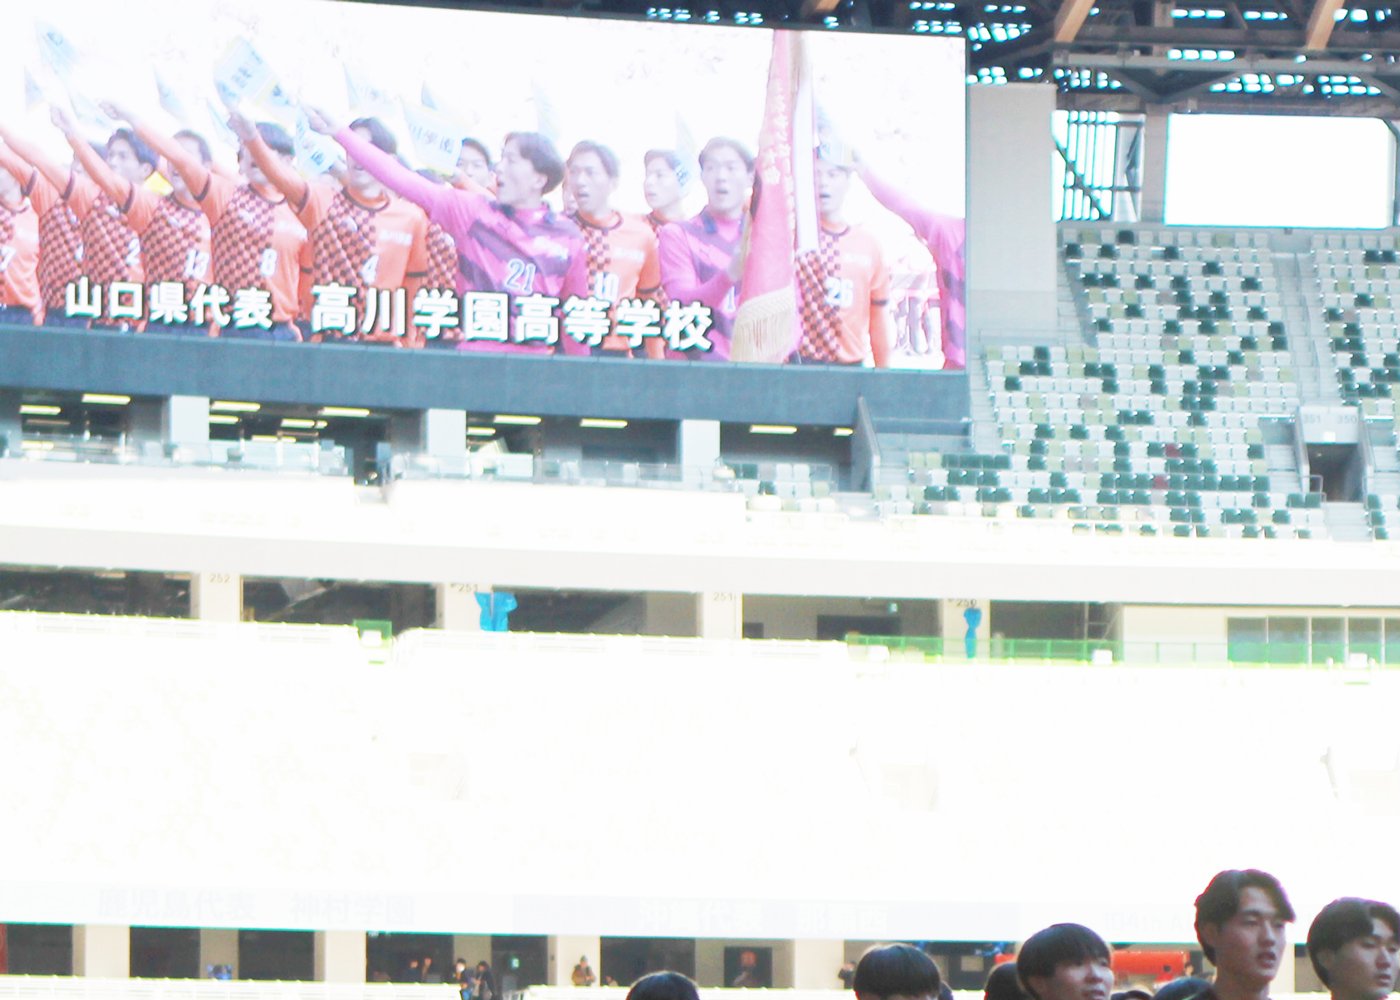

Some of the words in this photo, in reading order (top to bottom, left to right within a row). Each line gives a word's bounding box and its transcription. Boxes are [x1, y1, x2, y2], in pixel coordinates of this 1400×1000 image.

[506, 258, 537, 294] 21
[65, 276, 274, 330] 山口県代表
[310, 282, 713, 350] 高川学園高等学校
